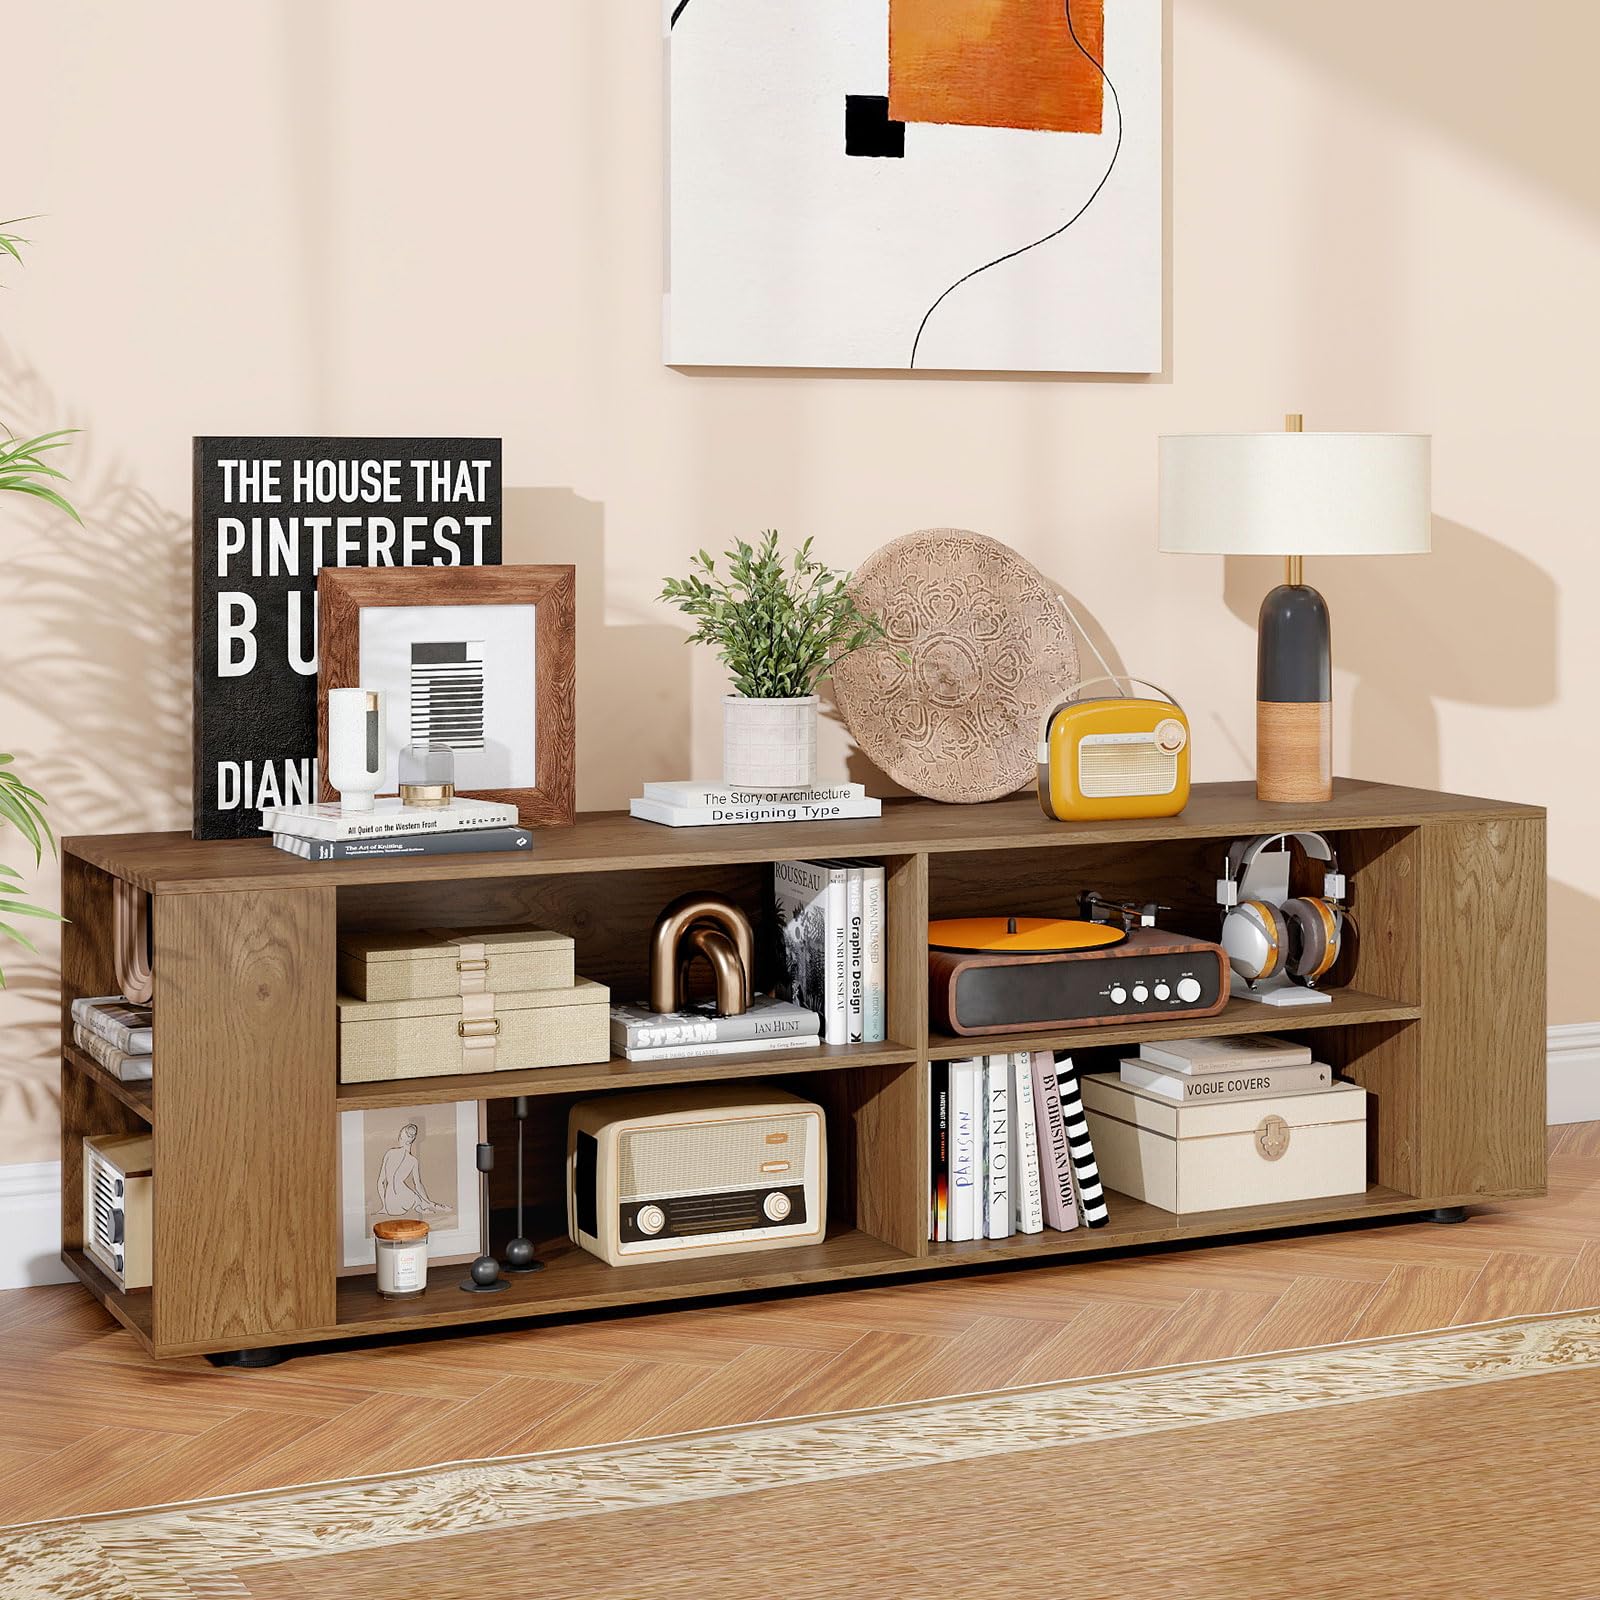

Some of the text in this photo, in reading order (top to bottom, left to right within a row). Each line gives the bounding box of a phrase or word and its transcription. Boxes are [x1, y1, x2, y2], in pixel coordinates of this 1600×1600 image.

[217, 459, 492, 503] THE HOUSE THAT
[217, 516, 492, 577] PINTEREST
[217, 590, 319, 678] BU
[217, 758, 319, 811] DIAN
[703, 788, 851, 806] The Story of Architecture
[347, 826, 357, 835] All
[357, 825, 374, 836] Quiet
[384, 823, 395, 832] the
[395, 821, 421, 832] Western
[421, 820, 438, 830] Front
[712, 805, 841, 822] Designing Type
[345, 844, 359, 852] The
[359, 843, 370, 851] Art
[775, 862, 821, 892] ROUSSEAU
[870, 886, 879, 965] WOMAN UNLEASHED
[836, 927, 845, 1012] HENRI ROUSSEAU
[849, 916, 862, 1015] Graphic Design
[637, 1022, 718, 1048] STEAM
[754, 1020, 801, 1034] IAN HUNT
[1022, 1086, 1031, 1104] LEE
[1186, 1077, 1271, 1096] VOGUE COVERS
[953, 1111, 974, 1188] PARISIAN
[992, 1088, 1007, 1205] KINFOLK
[1043, 1074, 1074, 1209] BY CHRISTIAN DIOR
[1024, 1122, 1041, 1228] TRANQUILITY
